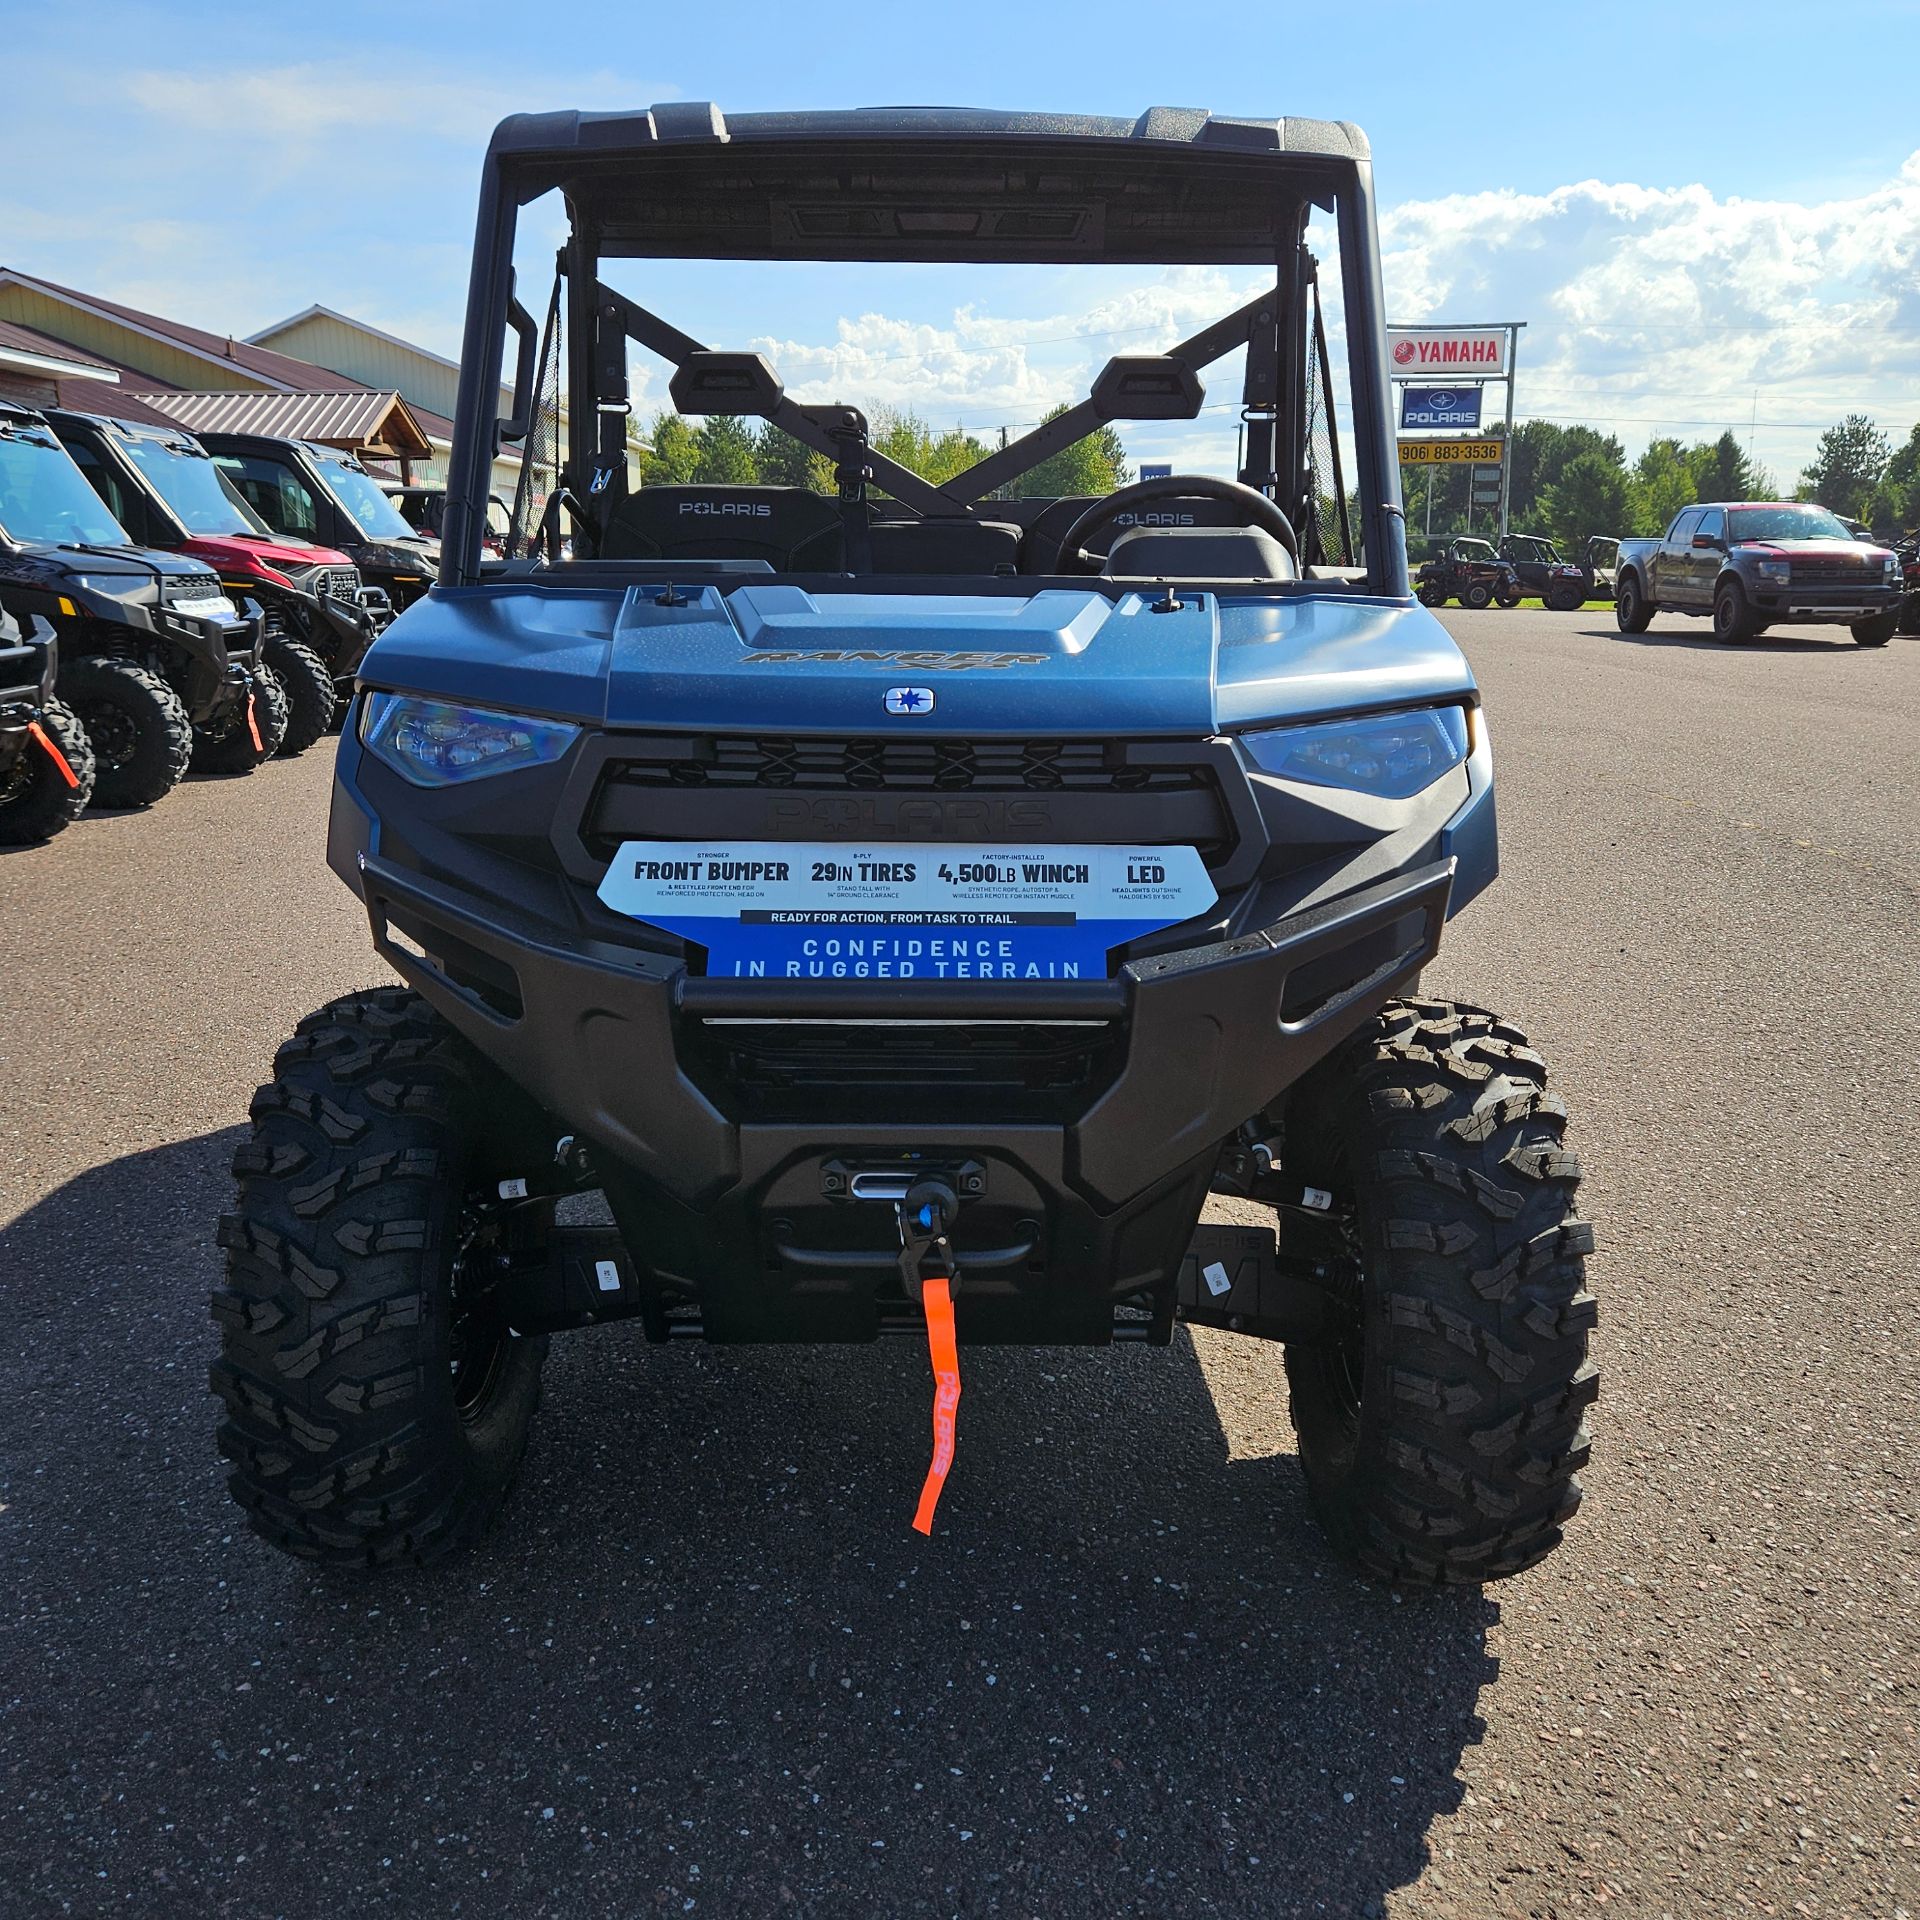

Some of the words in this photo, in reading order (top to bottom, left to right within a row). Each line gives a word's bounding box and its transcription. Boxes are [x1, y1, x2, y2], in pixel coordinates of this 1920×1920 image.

[1418, 341, 1498, 363] YAMAHA
[1405, 412, 1477, 423] POLARIS
[1433, 445, 1497, 460] 883-3536
[679, 502, 772, 516] POLARIS
[1113, 513, 1194, 525] OLARIS
[738, 650, 1051, 664] RANGER
[766, 797, 1054, 836] POLARIS
[634, 861, 703, 881] FRONT
[708, 862, 790, 881] BUMPER
[811, 862, 853, 882] 29IN
[858, 863, 917, 882] TIRES
[938, 863, 1016, 885] 4,500LB
[1021, 864, 1089, 883] WINCH
[1127, 865, 1165, 884] LED
[771, 912, 811, 923] READY
[814, 913, 837, 923] FOR
[839, 913, 887, 924] ACTION,
[890, 913, 923, 924] FROM
[925, 913, 957, 924] TASK
[960, 914, 976, 924] TO
[979, 914, 1017, 924] TRAIL.
[803, 939, 1013, 957] CONFIDENCE
[734, 960, 765, 978] IN
[786, 960, 915, 979] RUGGED
[935, 961, 1079, 979] TERRAIN
[933, 1370, 957, 1477] POLARIS
